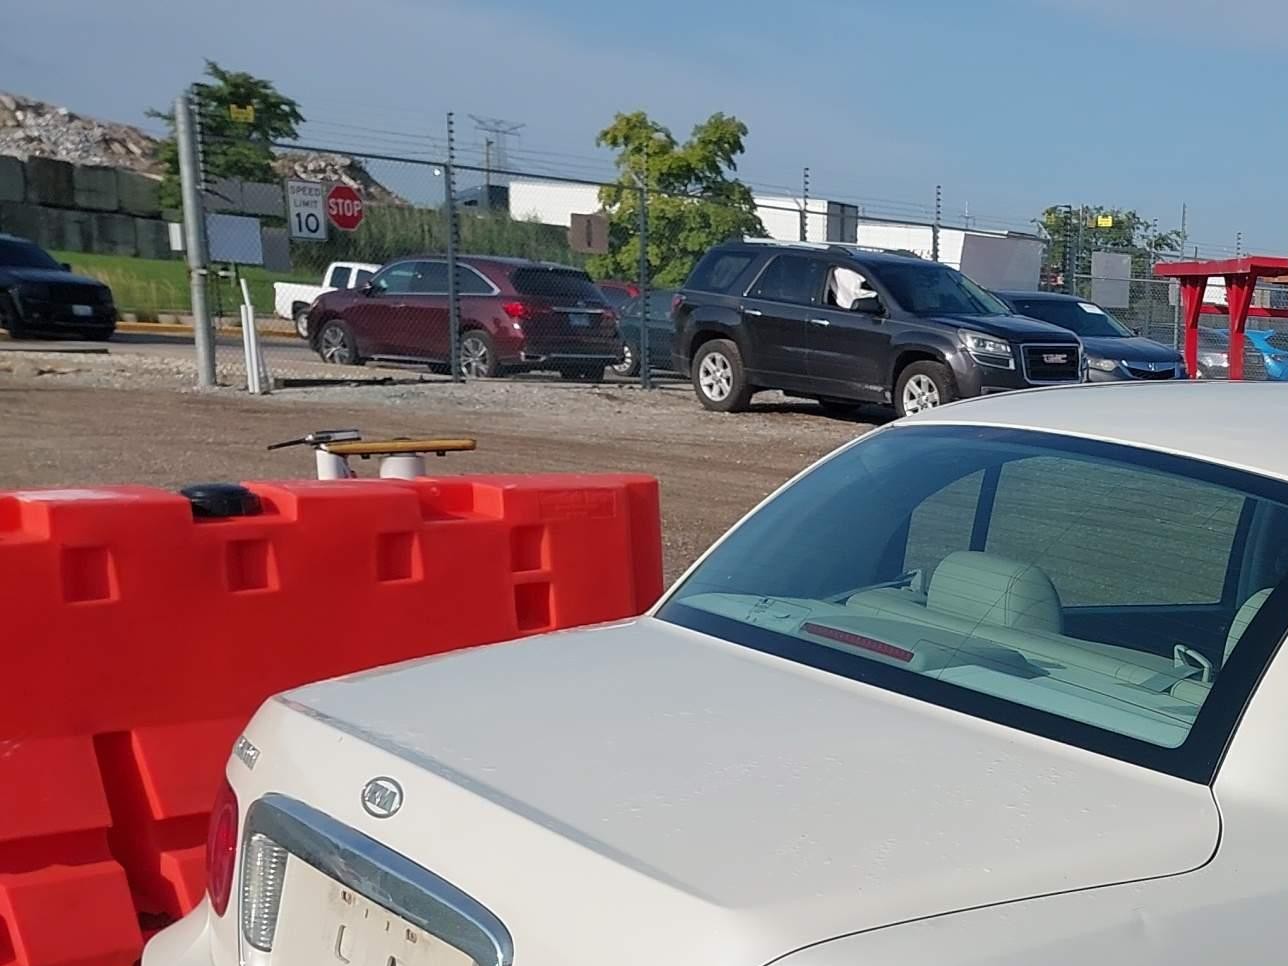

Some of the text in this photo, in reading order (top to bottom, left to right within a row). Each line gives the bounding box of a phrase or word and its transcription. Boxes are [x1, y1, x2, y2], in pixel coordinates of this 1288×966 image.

[290, 185, 321, 196] SPEED
[294, 199, 318, 209] LIMIT
[328, 198, 361, 217] STOP
[295, 211, 320, 233] 10
